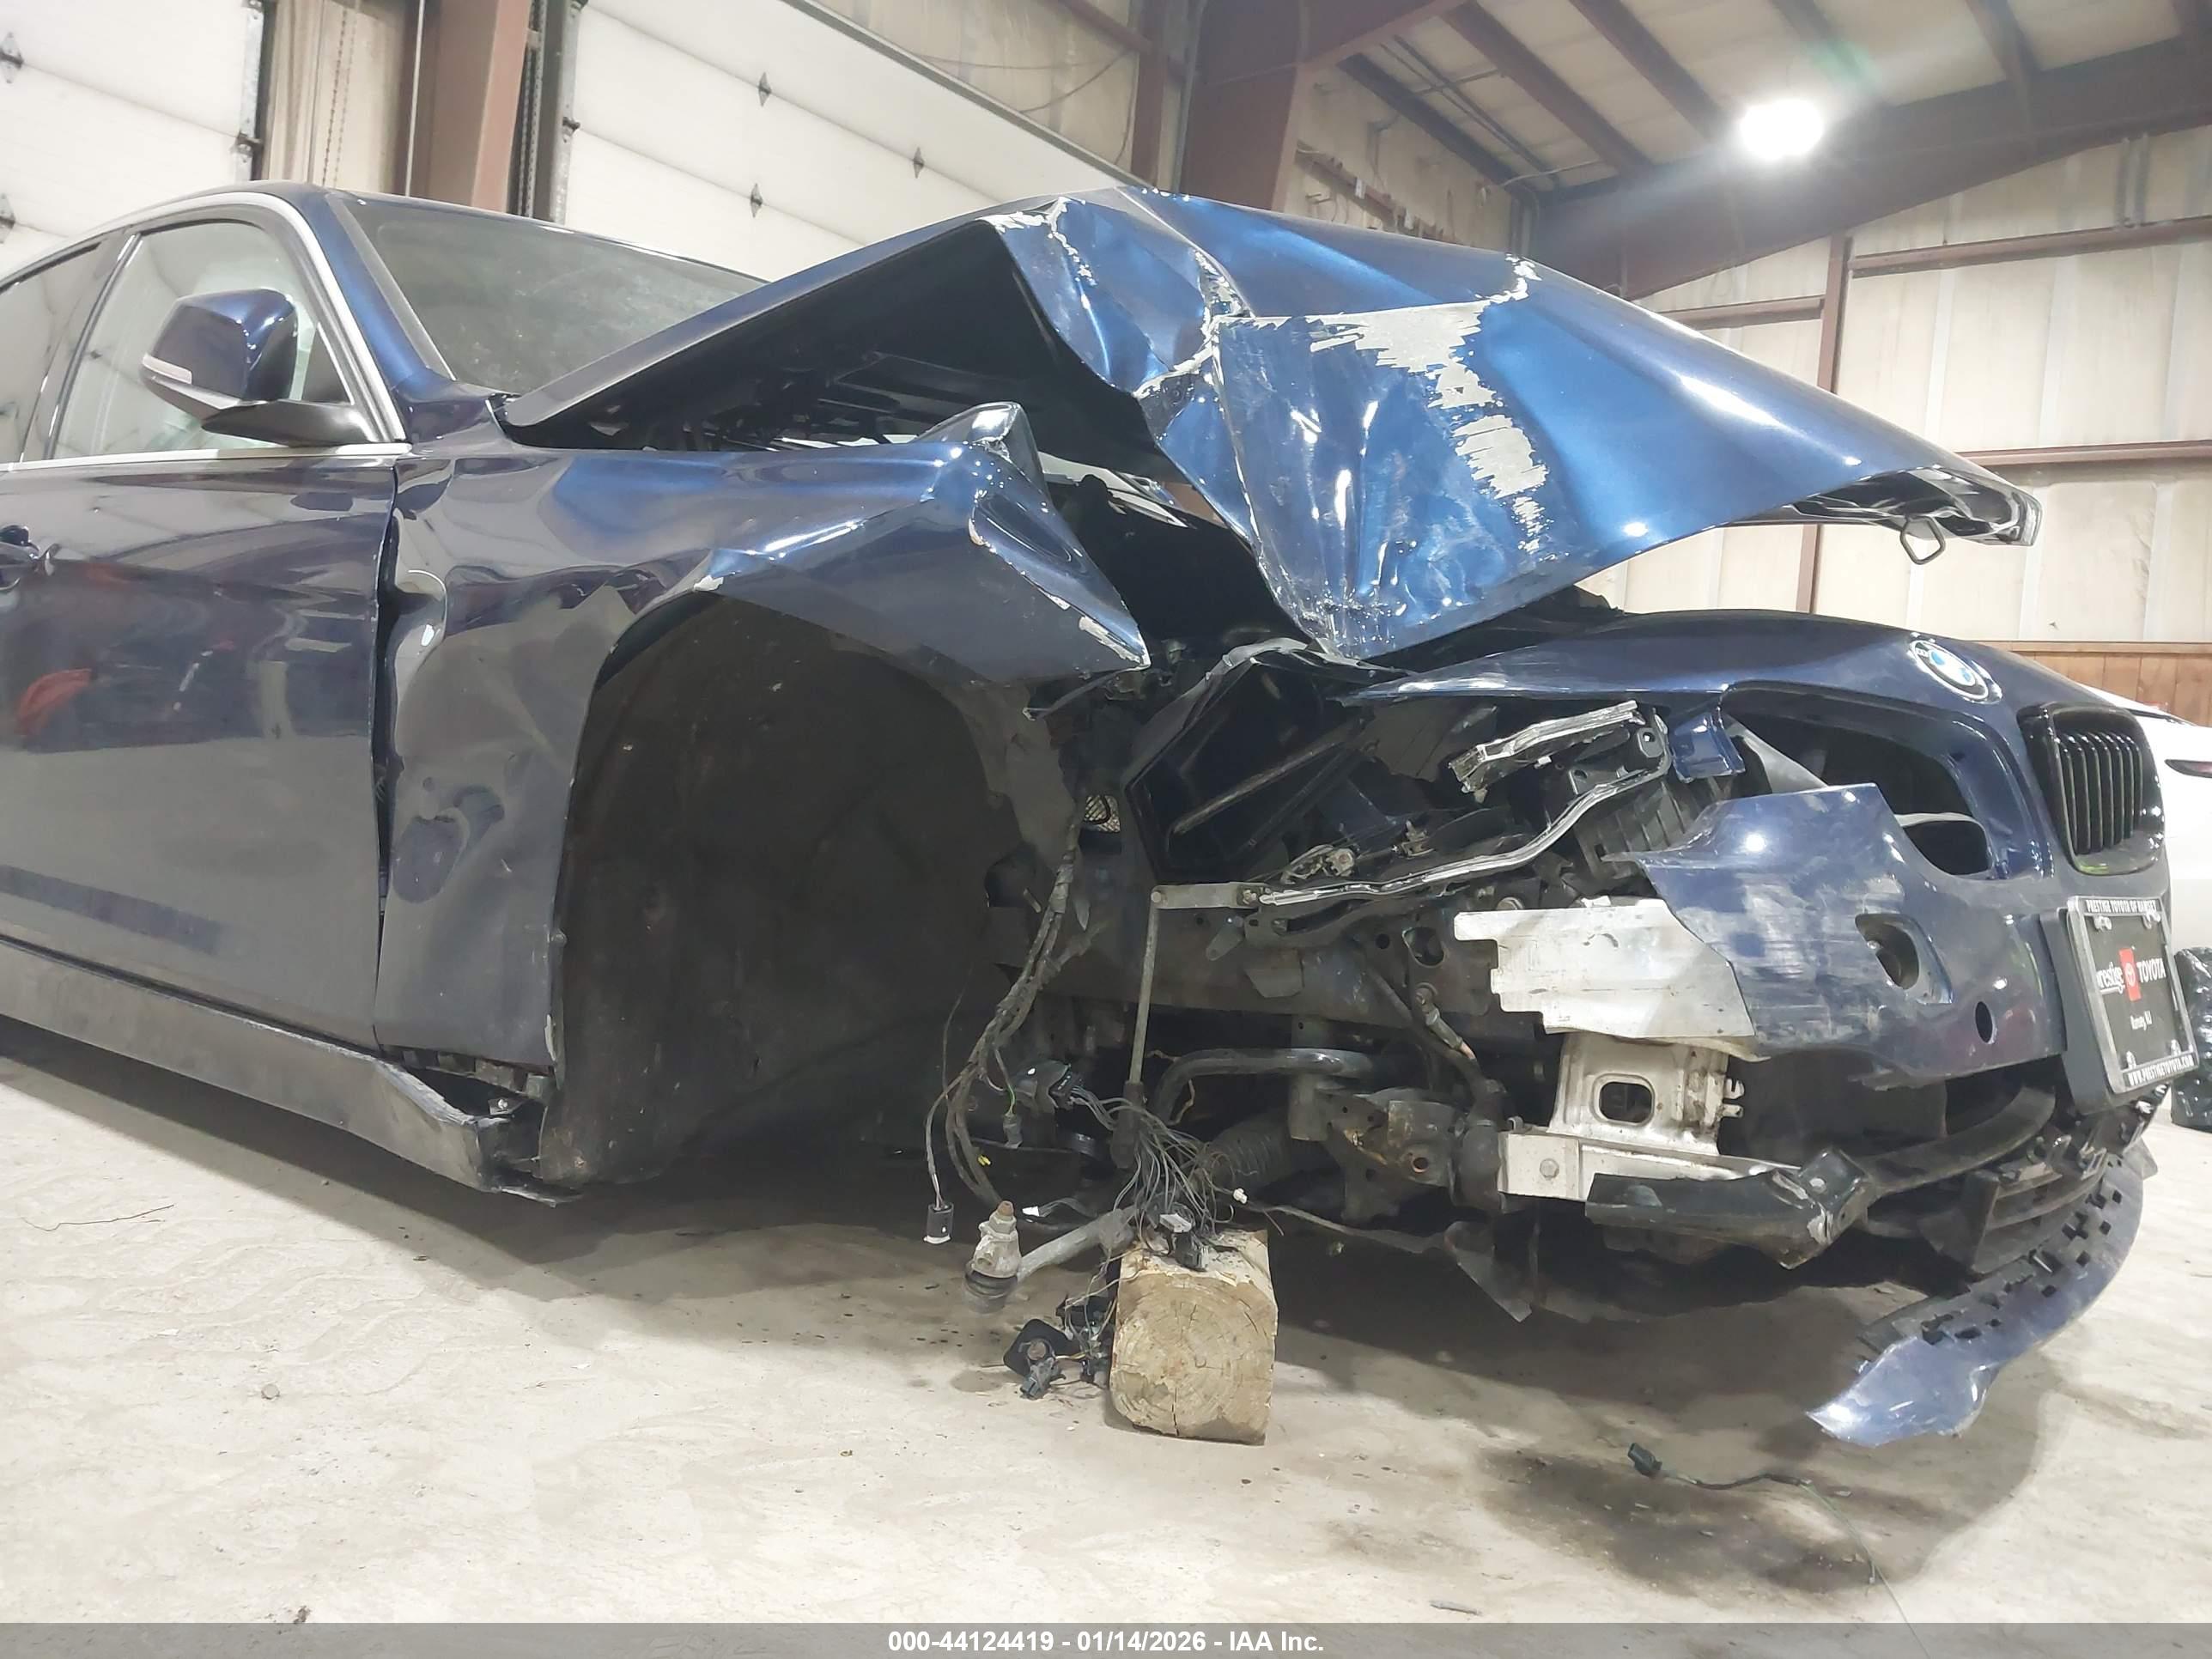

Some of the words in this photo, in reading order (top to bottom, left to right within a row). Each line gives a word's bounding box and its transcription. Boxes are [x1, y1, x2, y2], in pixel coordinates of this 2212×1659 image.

[2086, 899, 2112, 913] PRESTIGE
[2110, 899, 2131, 913] TOYOTA
[2136, 957, 2166, 983] TOYOTA
[2128, 1054, 2195, 1086] WWW.PRESTIGETOYOTA.COM
